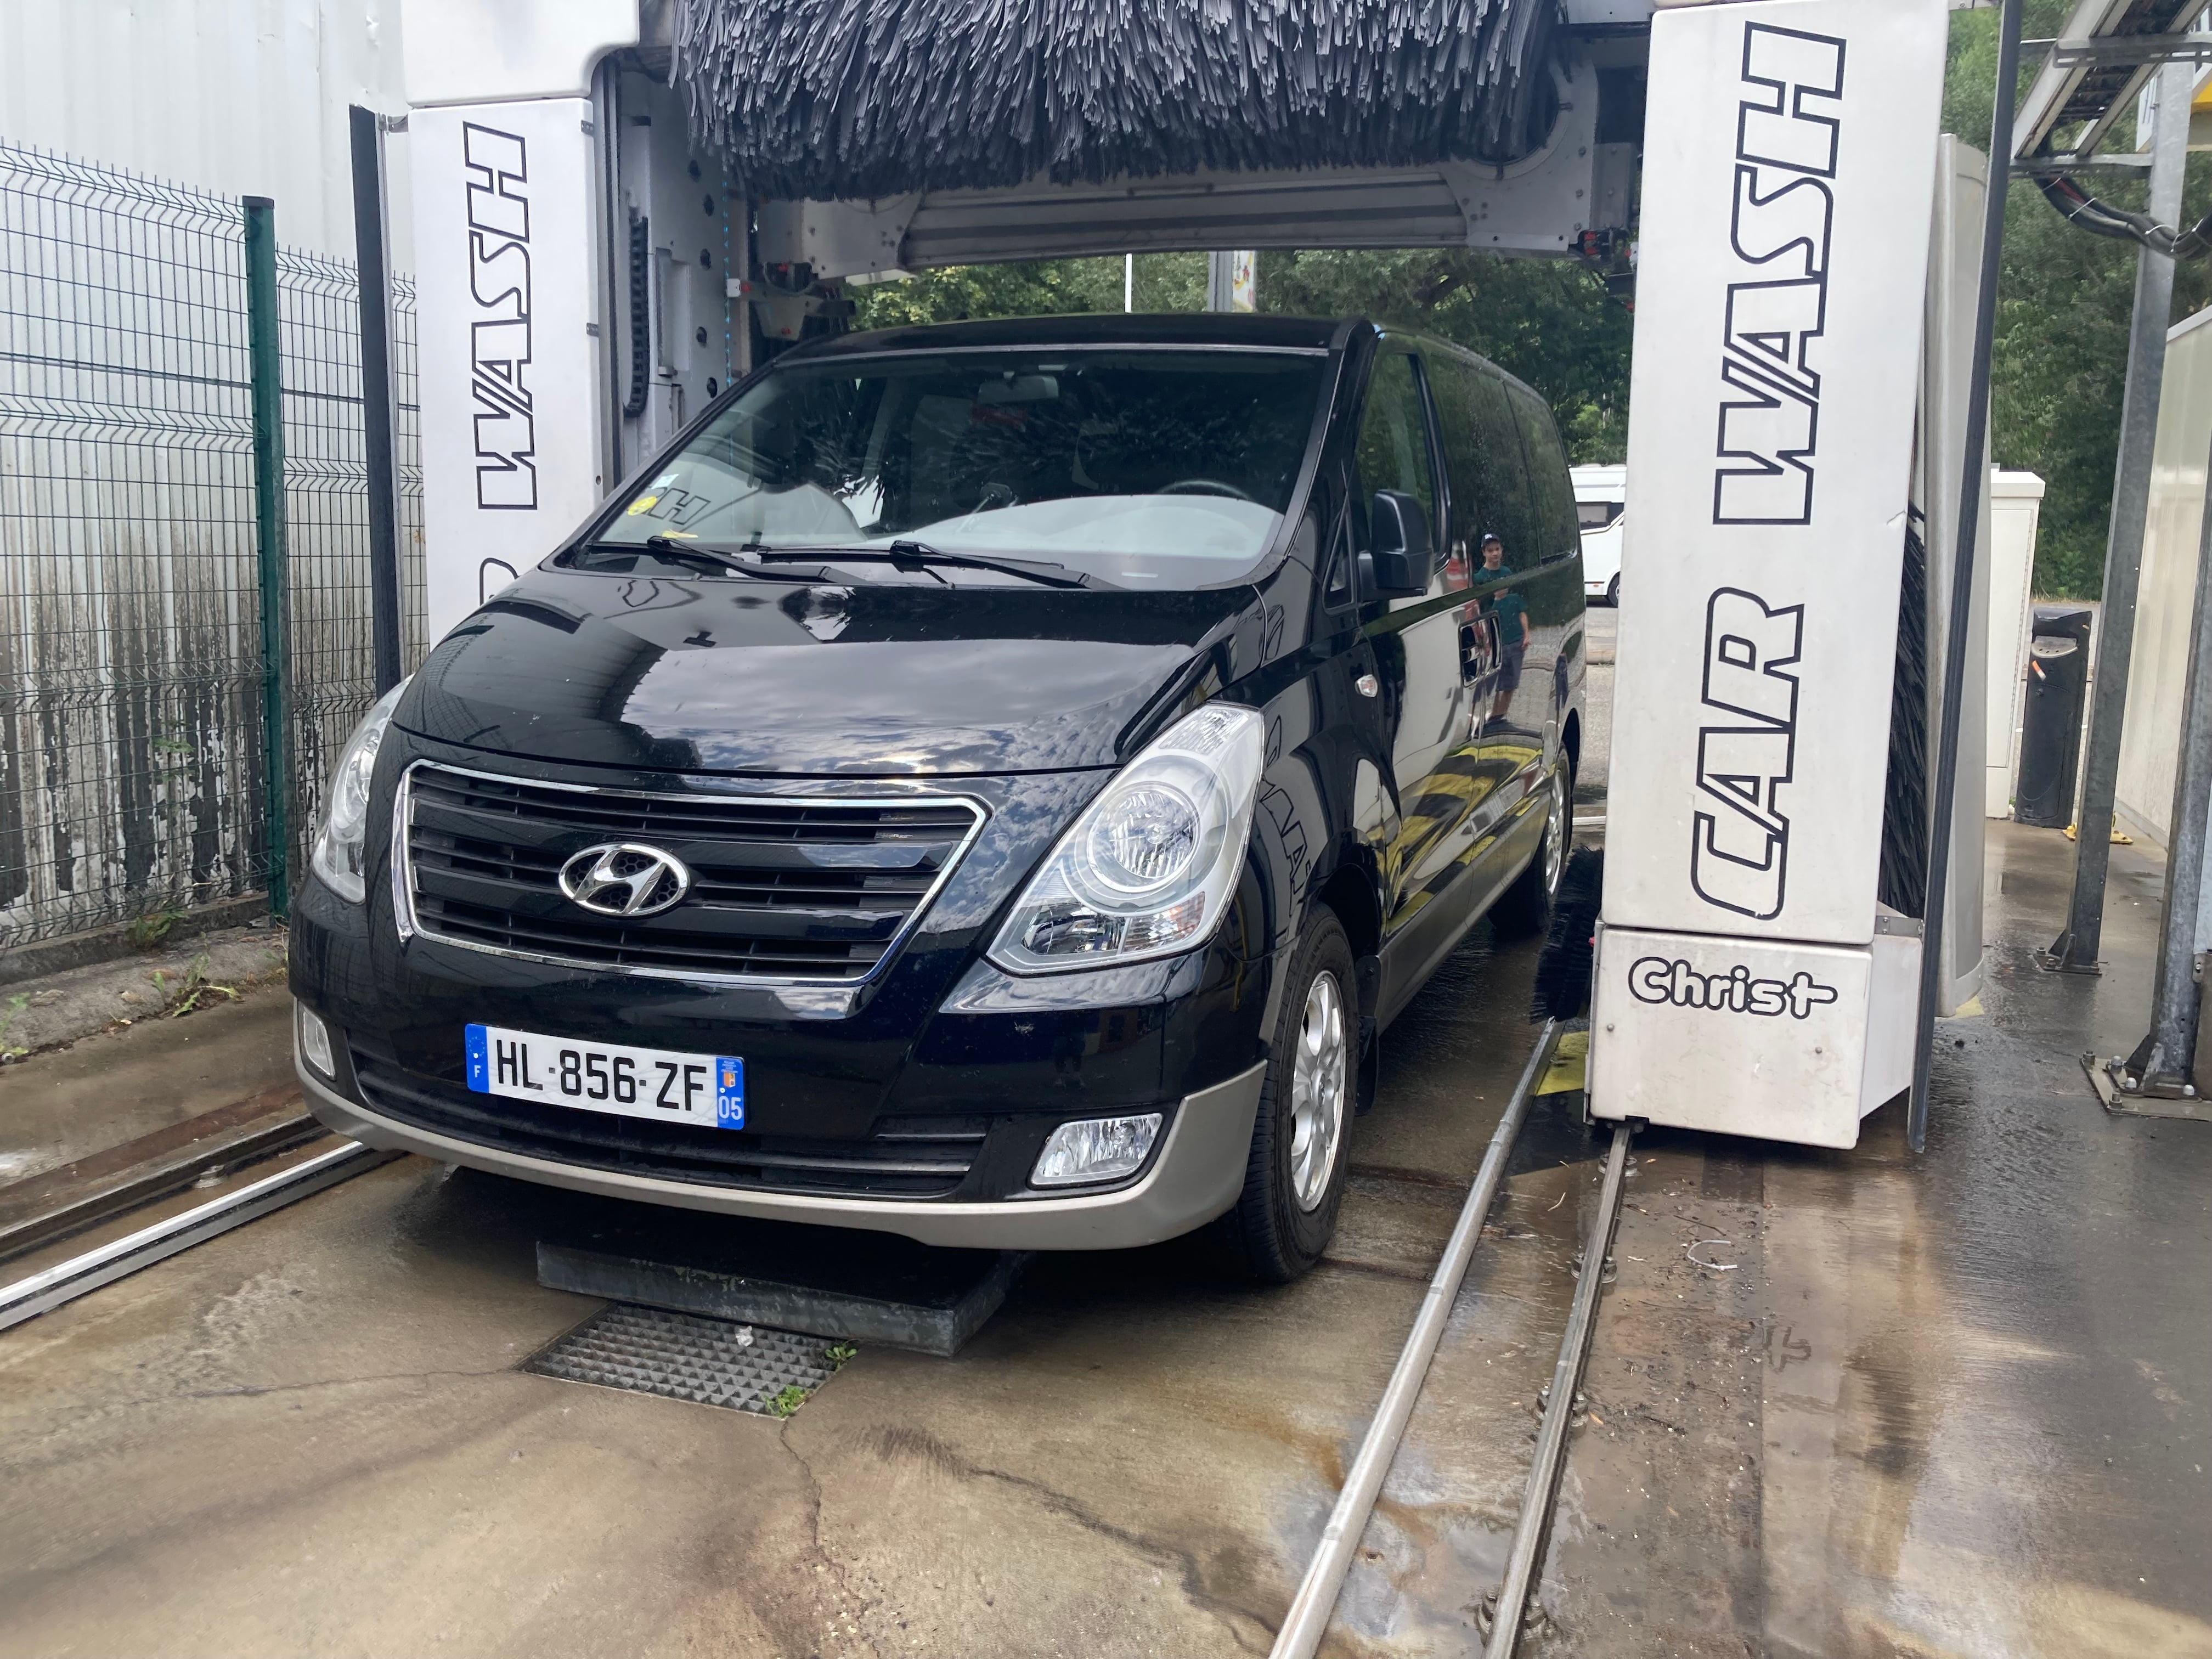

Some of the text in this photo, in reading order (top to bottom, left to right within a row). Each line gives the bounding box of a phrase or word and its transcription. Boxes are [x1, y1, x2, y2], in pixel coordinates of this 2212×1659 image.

[462, 120, 538, 510] WASH
[1691, 20, 1847, 920] CAR WASH
[1628, 956, 1838, 1020] Christ
[473, 1065, 481, 1078] F
[496, 1039, 708, 1111] HL-856-ZF
[718, 1096, 742, 1120] 05
